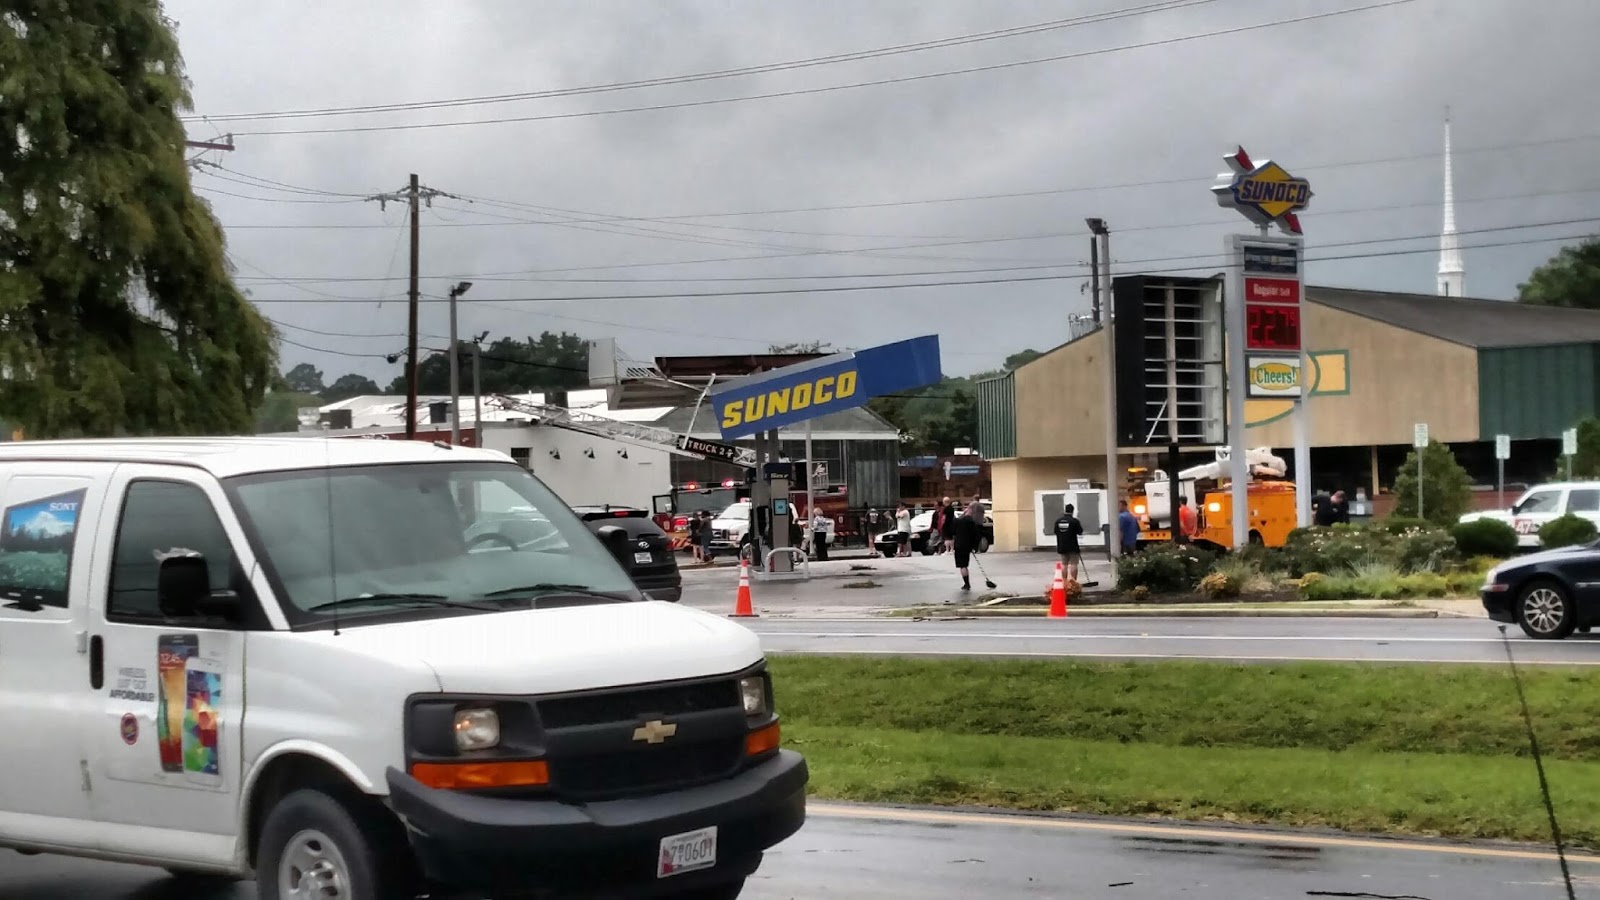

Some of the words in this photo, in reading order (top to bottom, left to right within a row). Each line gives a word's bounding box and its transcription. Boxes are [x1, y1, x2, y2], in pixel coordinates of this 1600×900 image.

[1241, 179, 1308, 204] SUNOCO
[1256, 365, 1296, 384] Cheers!
[721, 370, 858, 429] SUNOCO
[687, 440, 718, 454] TRUCK
[49, 502, 78, 511] SONY
